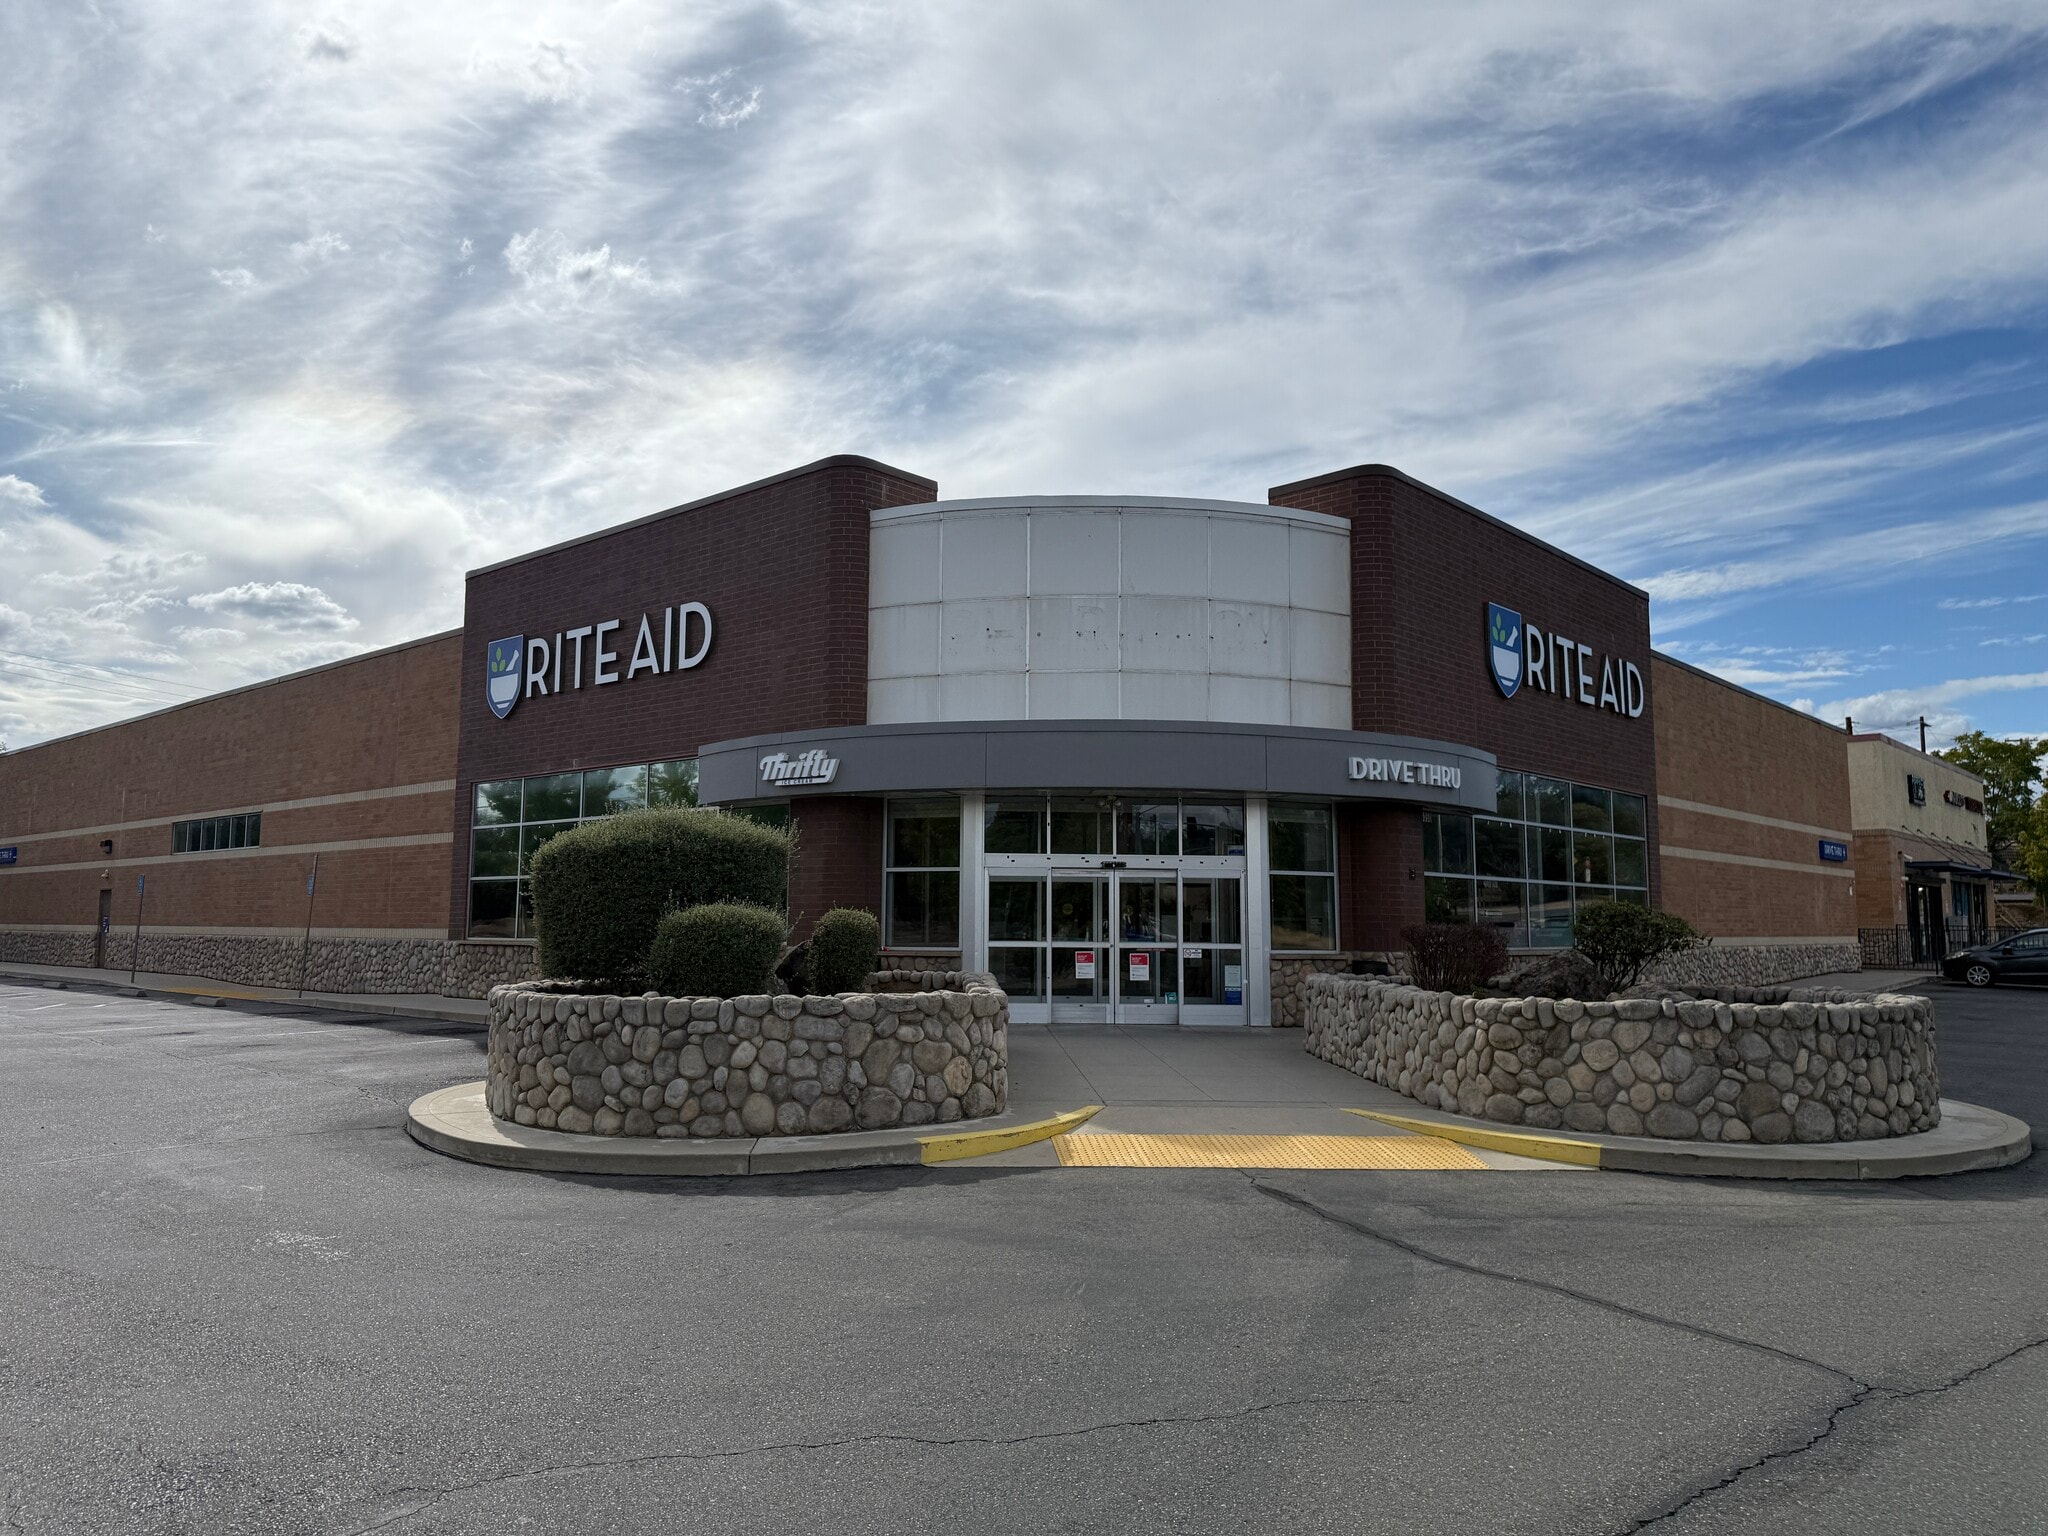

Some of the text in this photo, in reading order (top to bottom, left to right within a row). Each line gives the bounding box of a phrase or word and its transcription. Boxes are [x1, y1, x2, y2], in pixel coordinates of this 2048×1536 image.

[525, 602, 713, 697] RITE AID
[1526, 623, 1645, 719] RITE AID
[760, 749, 840, 783] Thrifty
[1348, 756, 1462, 789] DRIVE THRU
